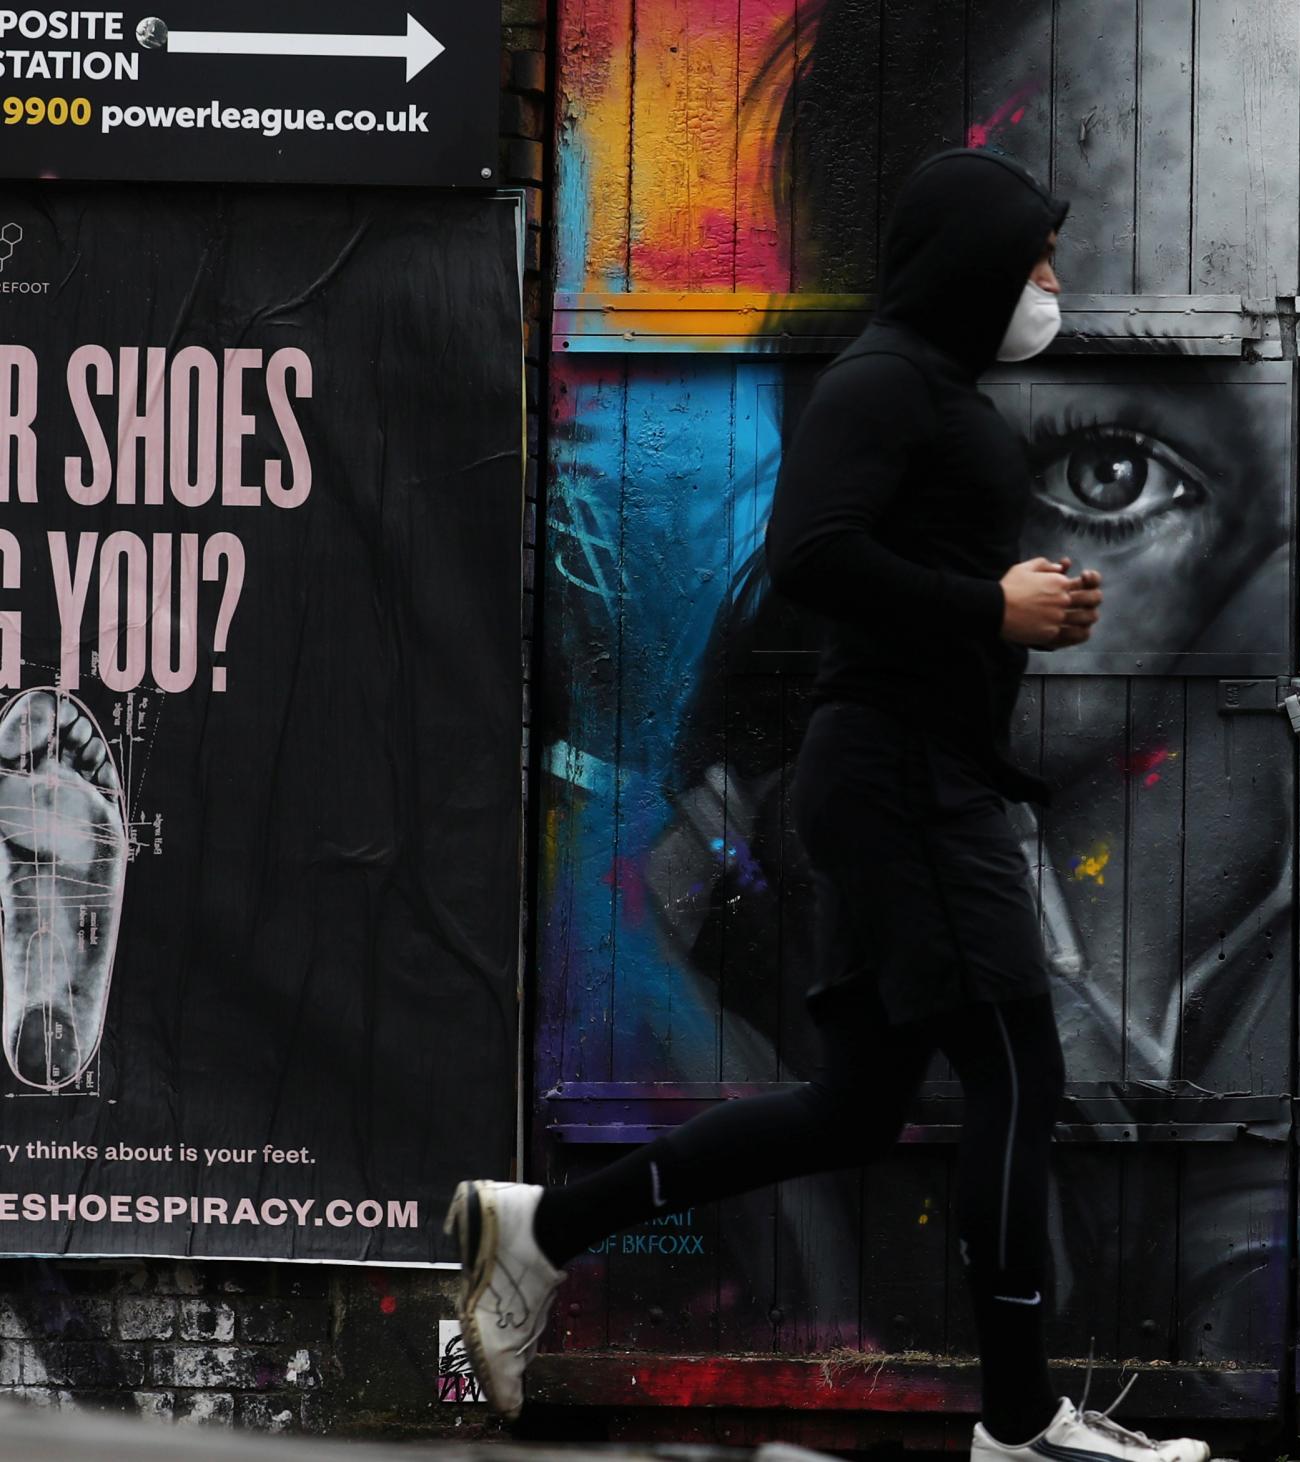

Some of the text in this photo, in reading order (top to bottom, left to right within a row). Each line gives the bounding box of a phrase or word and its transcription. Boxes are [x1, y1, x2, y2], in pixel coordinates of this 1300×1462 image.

[2, 96, 429, 136] 9900 powerleague.co.uk
[0, 281, 50, 294] EFOOT
[64, 344, 313, 508] SHOES
[47, 530, 246, 693] YOU?
[25, 1140, 98, 1160] thinks
[104, 1141, 173, 1162] about
[179, 1142, 198, 1162] is
[203, 1148, 257, 1167] your
[262, 1144, 316, 1164] feet.
[0, 1193, 419, 1228] ESHOESPIRACY.COM
[622, 1234, 704, 1254] BKFOXX
